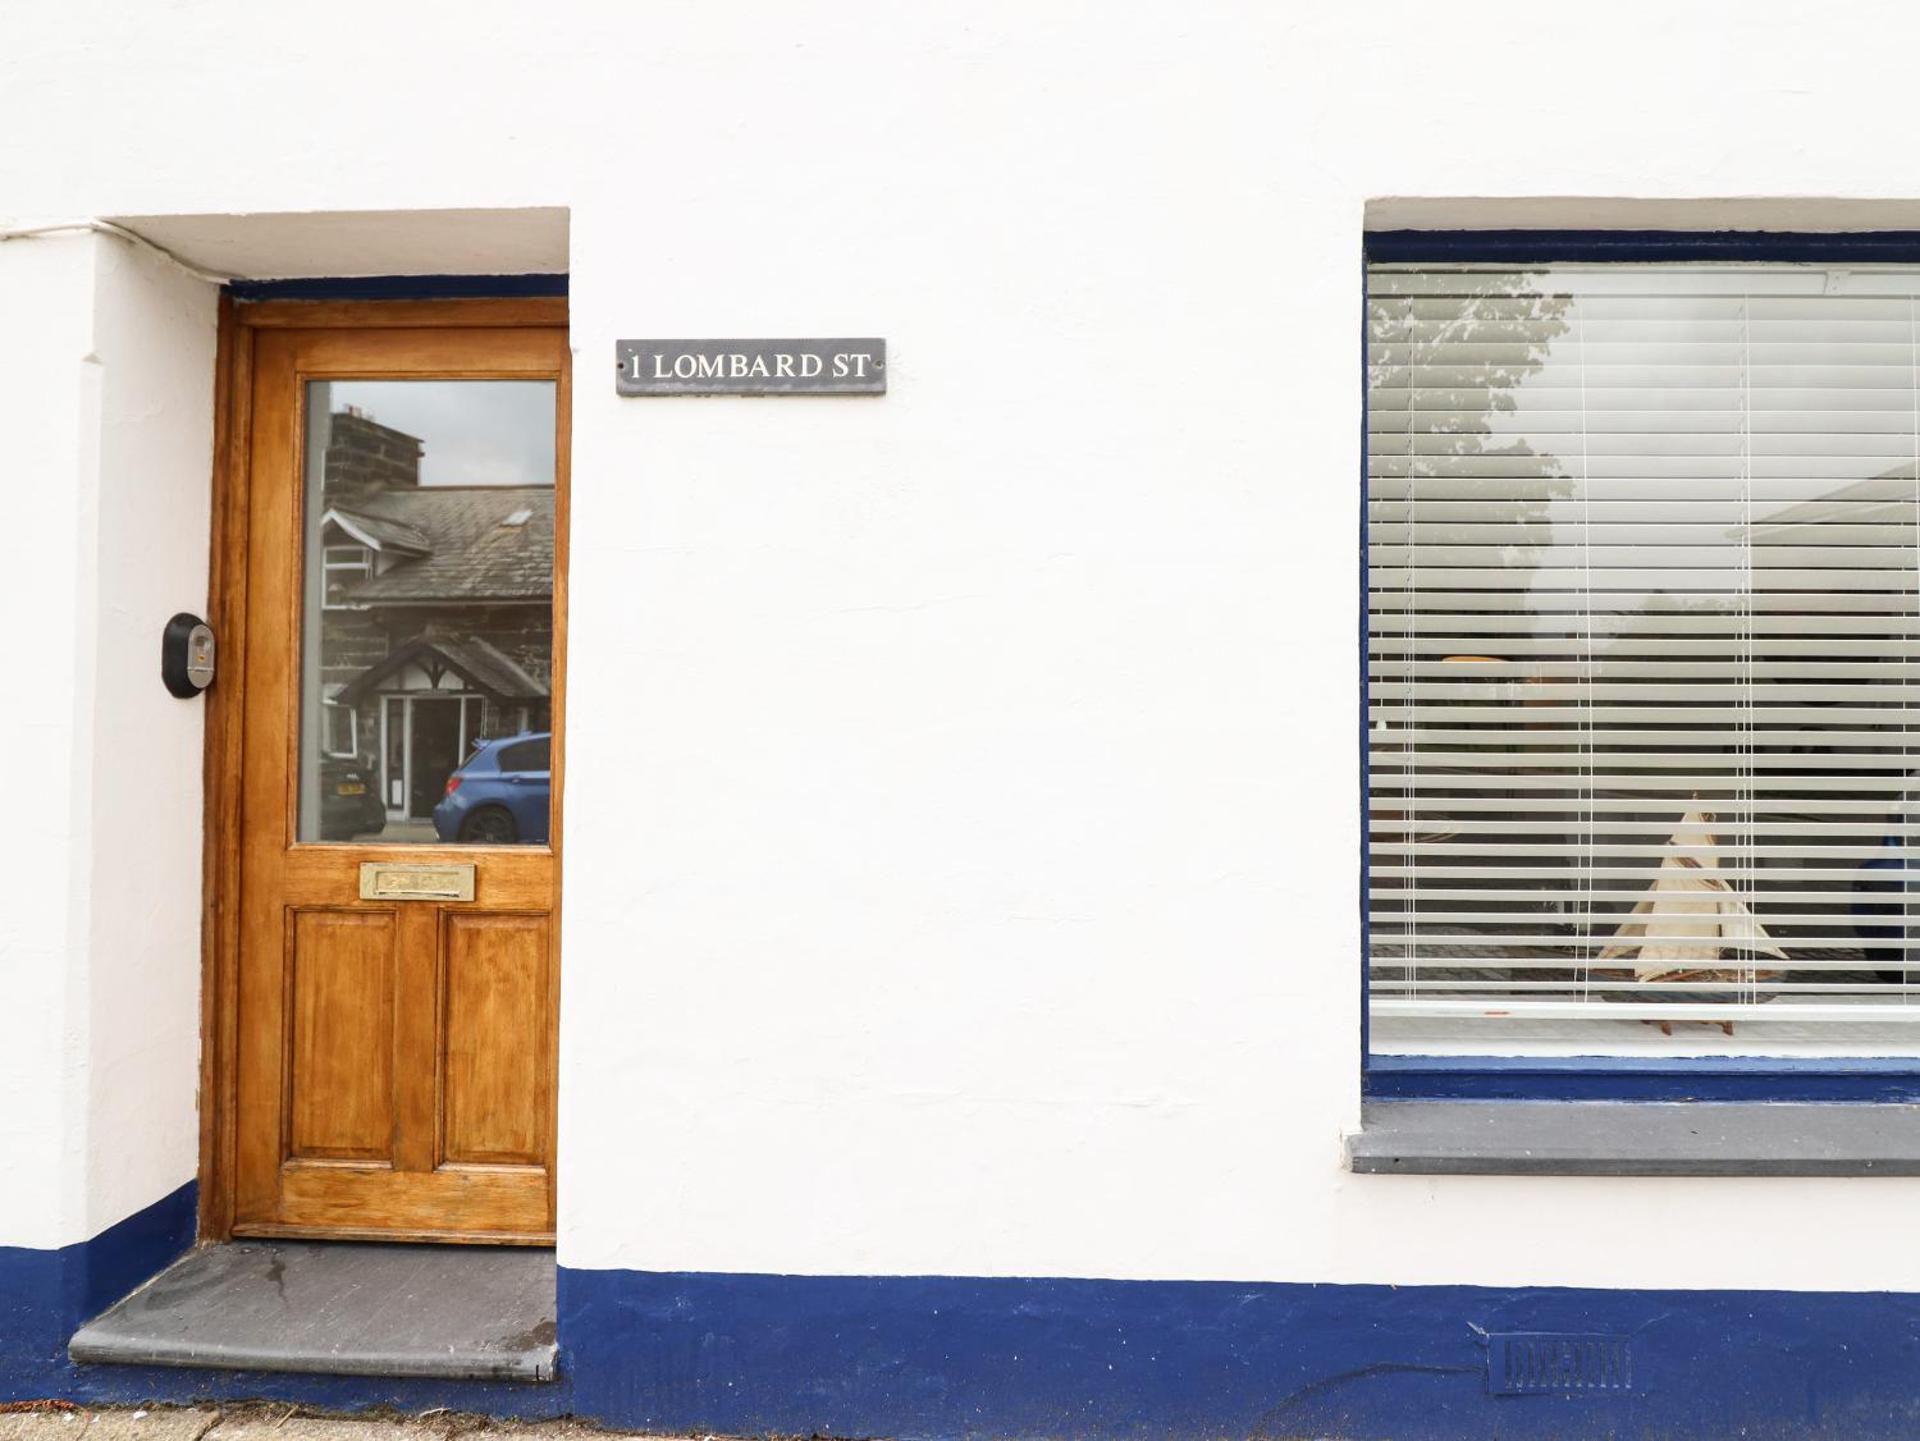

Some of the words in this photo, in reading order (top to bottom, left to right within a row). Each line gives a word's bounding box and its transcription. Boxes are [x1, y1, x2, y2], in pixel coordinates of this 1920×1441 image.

[631, 354, 640, 379] 1
[653, 353, 823, 378] LOMBARD
[832, 353, 872, 378] ST
